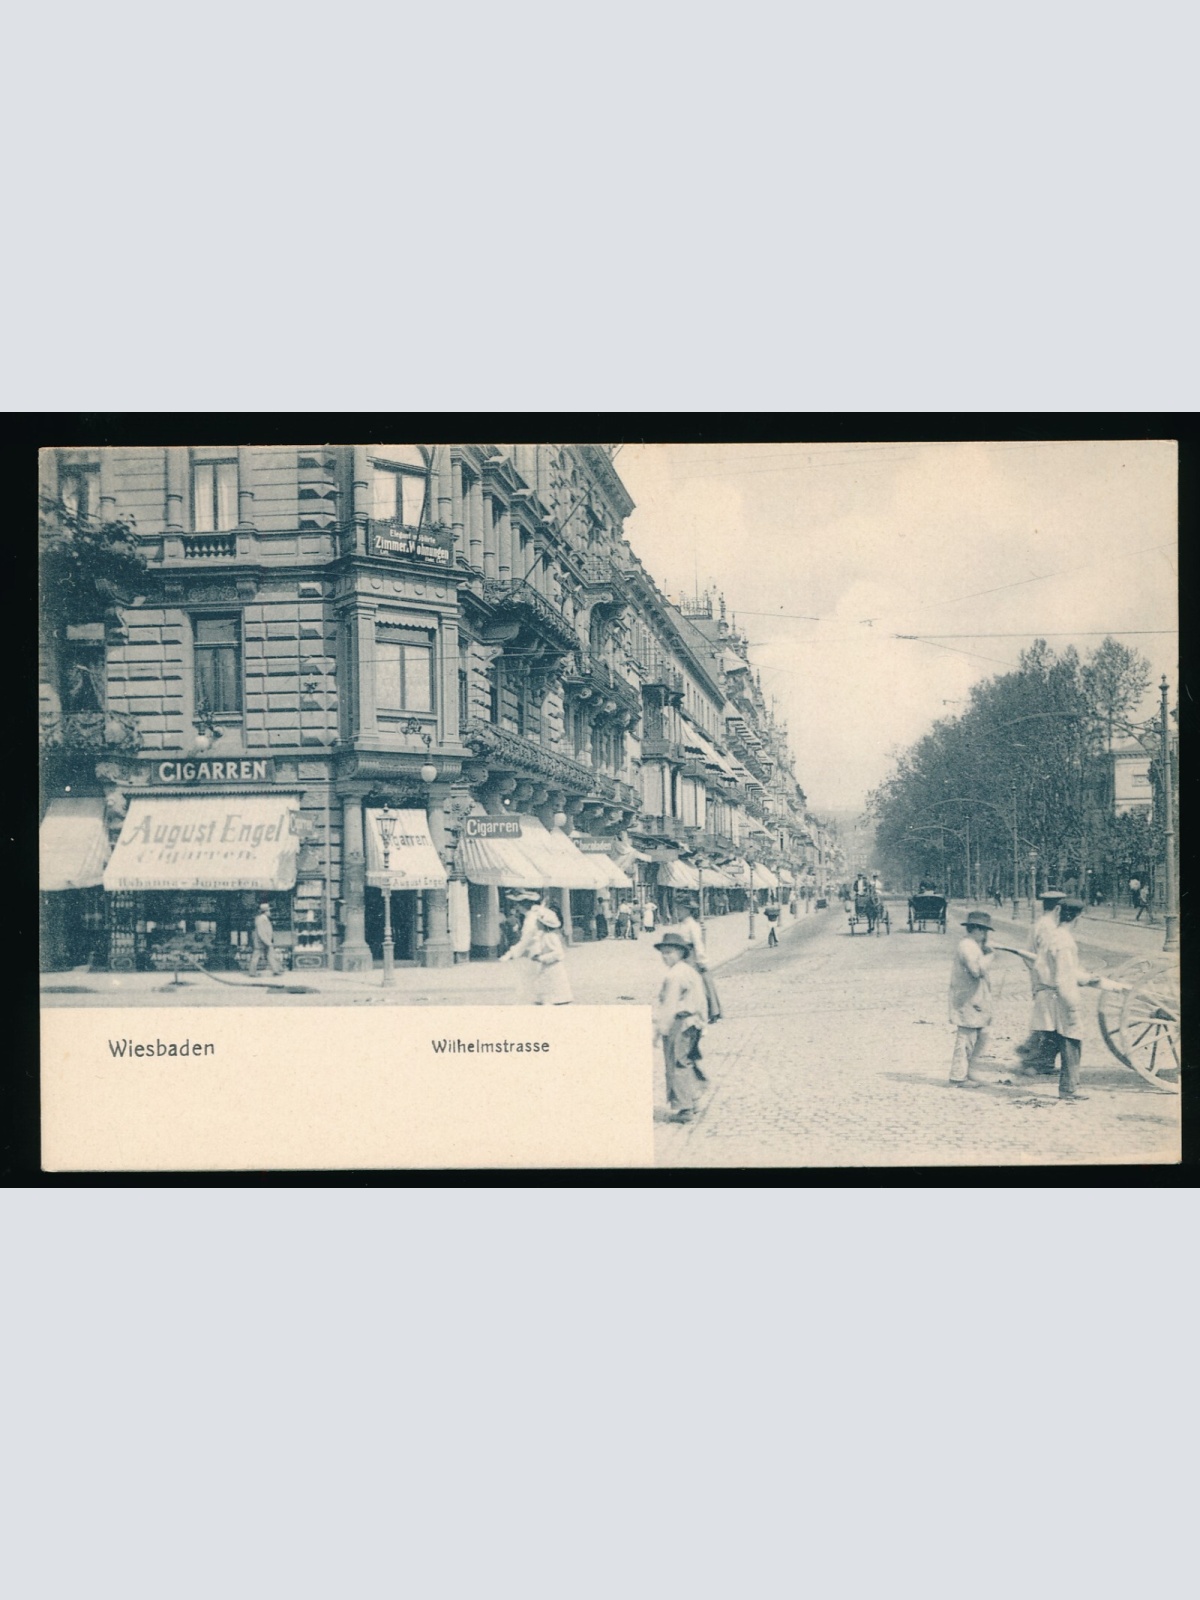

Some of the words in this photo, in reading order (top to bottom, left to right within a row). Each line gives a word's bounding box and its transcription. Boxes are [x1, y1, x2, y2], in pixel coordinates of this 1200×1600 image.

[158, 760, 268, 782] CIGARREN
[121, 814, 218, 849] August
[219, 813, 285, 849] Engel
[466, 818, 519, 836] Cigarren
